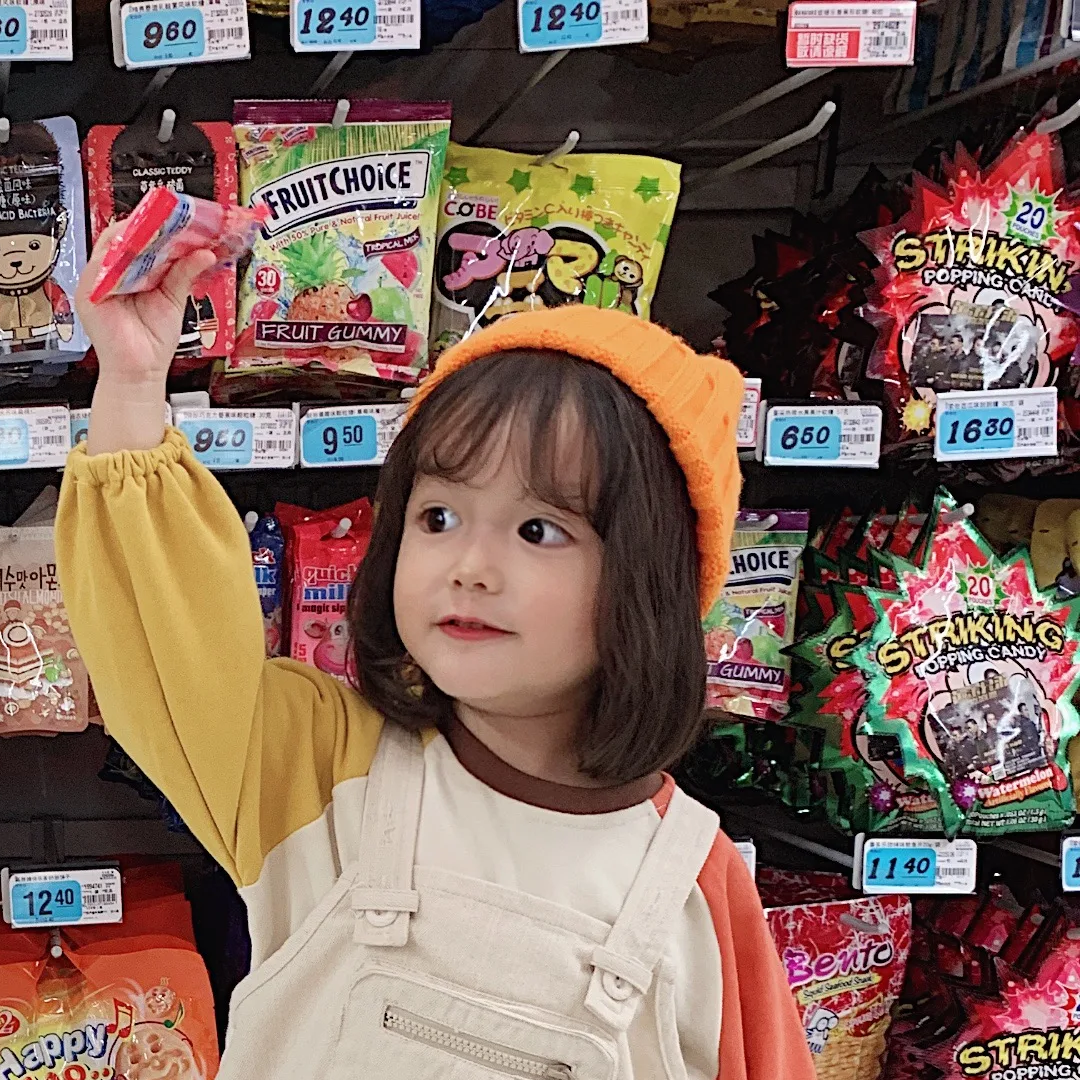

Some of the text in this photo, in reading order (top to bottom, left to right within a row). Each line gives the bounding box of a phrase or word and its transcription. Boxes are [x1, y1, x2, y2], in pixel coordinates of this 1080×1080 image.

[300, 6, 370, 35] 1240
[531, 1, 601, 33] 1240
[143, 19, 197, 49] 960
[132, 166, 193, 177] CLASSIC TEDDY
[260, 161, 412, 221] FRUITCHOICE
[19, 206, 57, 219] BACTERIA
[1015, 200, 1046, 230] 20
[270, 238, 290, 252] With
[291, 229, 309, 243] 50%
[310, 222, 330, 234] Pure
[373, 212, 393, 222] Fruit
[365, 233, 419, 253] TROPICAL MIX
[257, 269, 276, 287] 30
[923, 267, 1004, 289] POPPING
[260, 323, 403, 342] FRUIT GUMMY
[322, 423, 363, 455] 950
[947, 416, 1014, 446] 1630
[968, 575, 991, 597] 20
[878, 615, 1064, 674] STRIKING
[988, 645, 1047, 662] CANDY
[720, 662, 782, 683] GUMMY
[978, 766, 1054, 799] Watermelon
[867, 857, 930, 880] 1140
[23, 888, 75, 917] 1240
[784, 942, 893, 987] Bento
